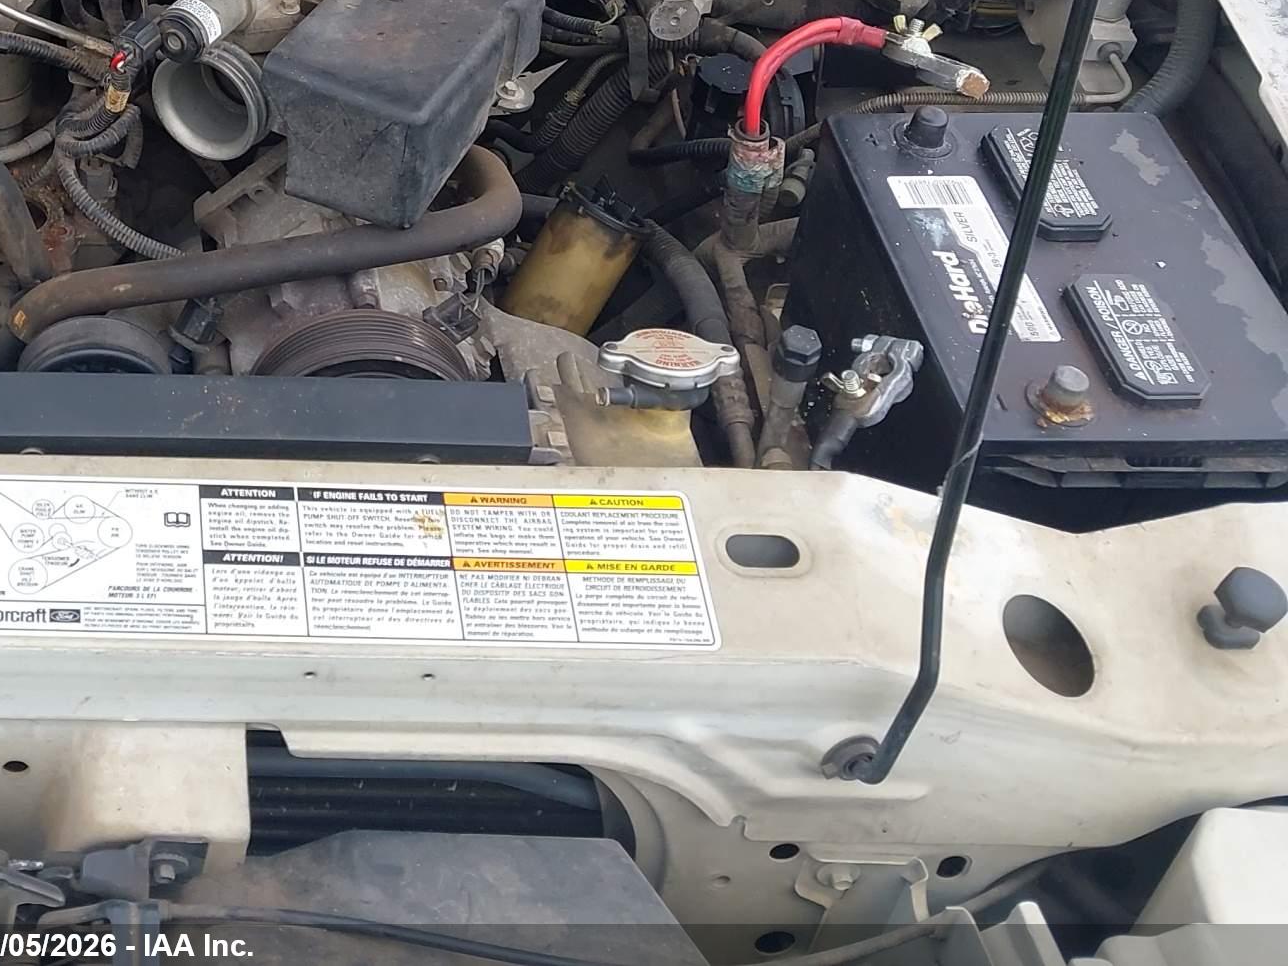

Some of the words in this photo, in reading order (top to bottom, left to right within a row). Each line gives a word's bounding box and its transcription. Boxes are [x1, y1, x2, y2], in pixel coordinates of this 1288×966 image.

[954, 212, 978, 243] SILVER
[932, 250, 989, 334] DieHard
[1086, 286, 1114, 321] POISON
[1112, 329, 1140, 372] DANGER
[221, 488, 276, 497] ATTENTION
[323, 492, 357, 500] ENGINE
[358, 492, 383, 500] FAILS
[400, 494, 427, 502] START
[222, 554, 284, 562] ATTENTION!
[327, 556, 361, 565] MOTEUR
[362, 558, 392, 566] REFUSE
[394, 558, 405, 566] DE
[407, 557, 450, 567] DÉMARRER
[474, 561, 555, 569] AVERTISSEMENT
